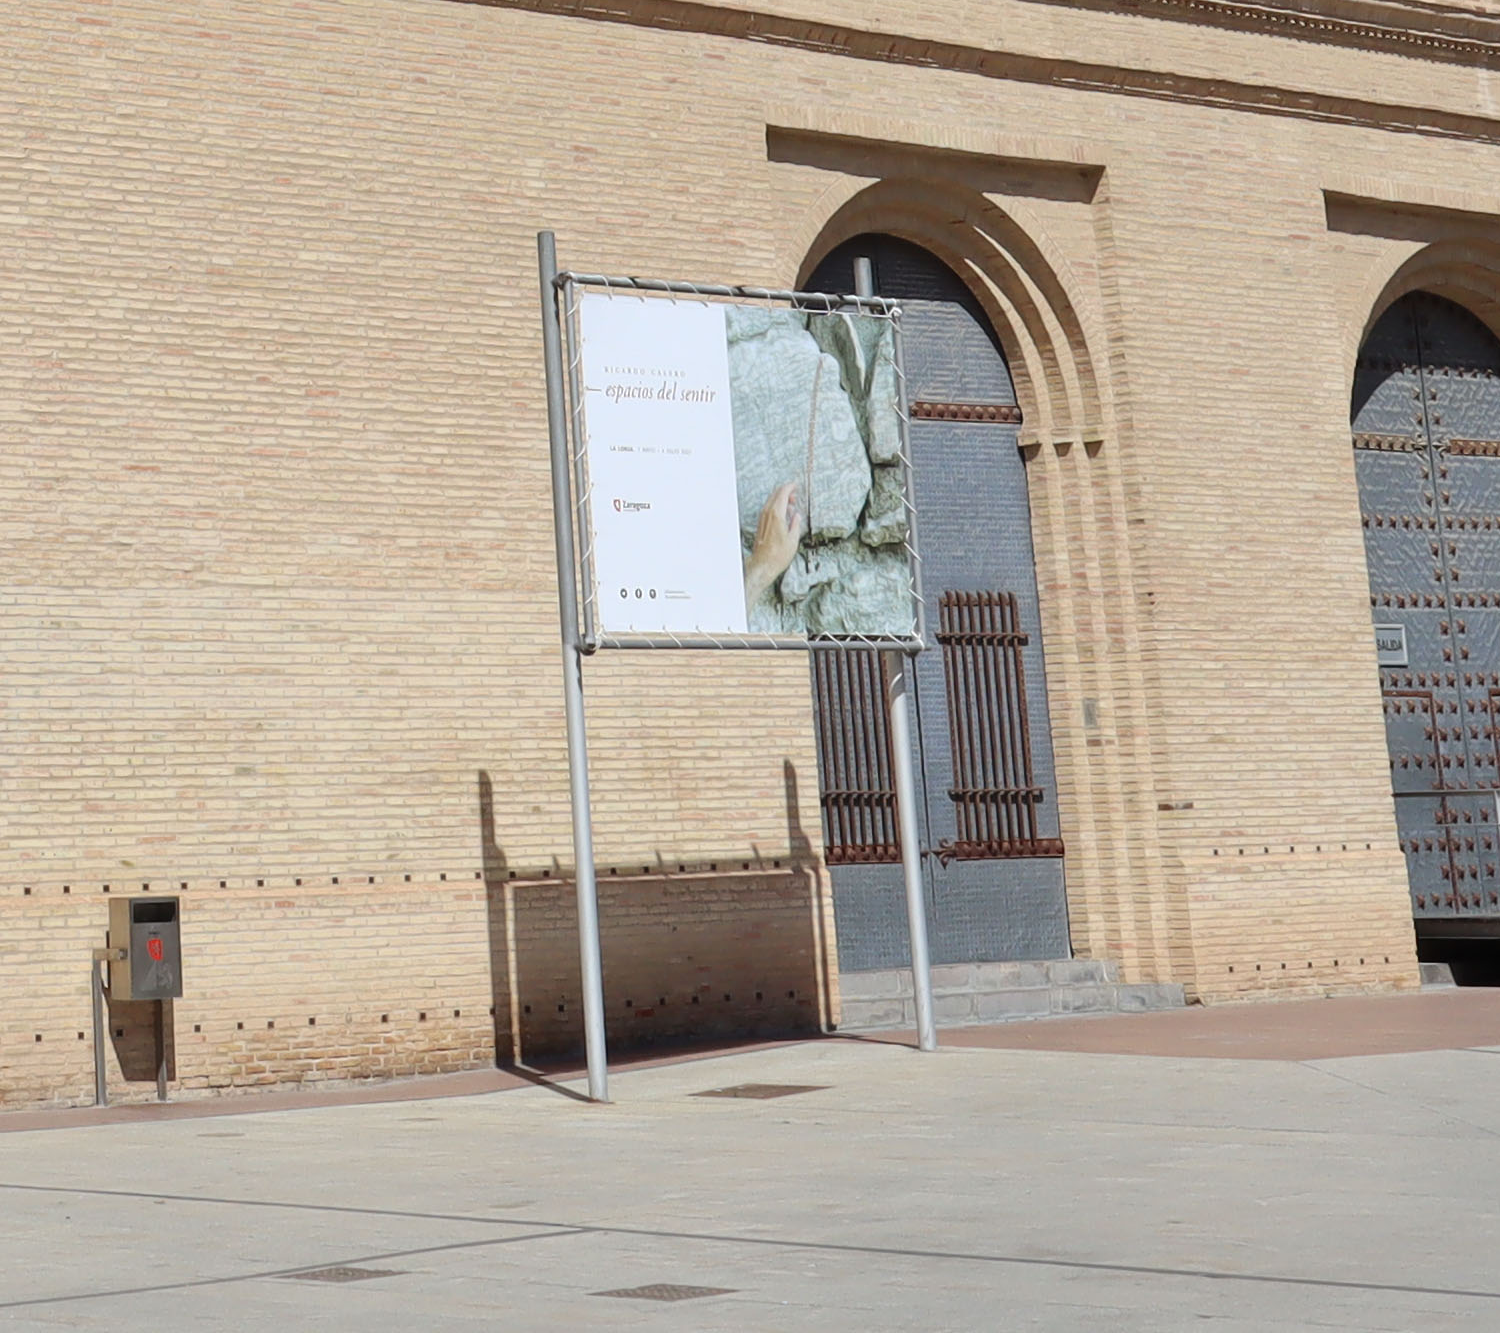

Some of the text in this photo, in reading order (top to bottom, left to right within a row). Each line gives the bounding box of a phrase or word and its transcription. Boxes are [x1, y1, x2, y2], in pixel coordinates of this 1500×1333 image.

[605, 380, 716, 404] espacios del sentir
